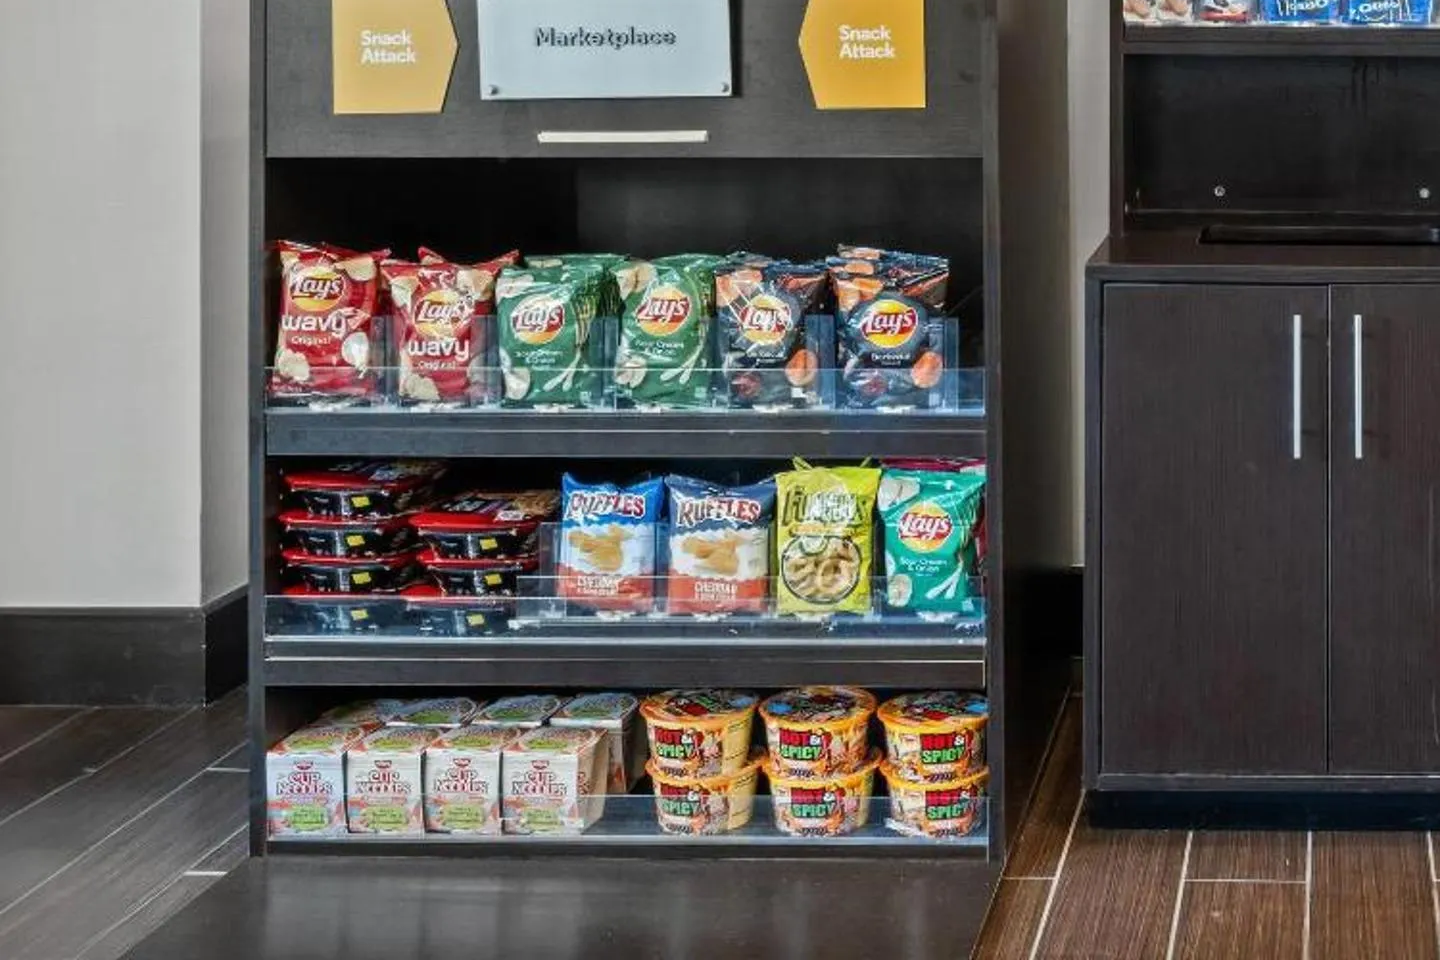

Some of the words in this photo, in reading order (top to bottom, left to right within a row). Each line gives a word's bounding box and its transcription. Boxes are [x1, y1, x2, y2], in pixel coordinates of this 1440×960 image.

[361, 29, 413, 46] Snack
[536, 26, 677, 51] Marketplace
[839, 24, 891, 41] Snack
[361, 47, 417, 64] Attack
[839, 42, 895, 59] Attack
[281, 314, 347, 339] wavy
[408, 337, 470, 362] wavy
[678, 496, 761, 527] RUFFLES
[656, 743, 694, 759] SPICY
[781, 745, 822, 761] SPICY
[921, 746, 965, 764] SPICY
[288, 771, 321, 783] CUP
[368, 770, 400, 782] CUP
[446, 768, 478, 779] CUP
[524, 771, 557, 781] CUP
